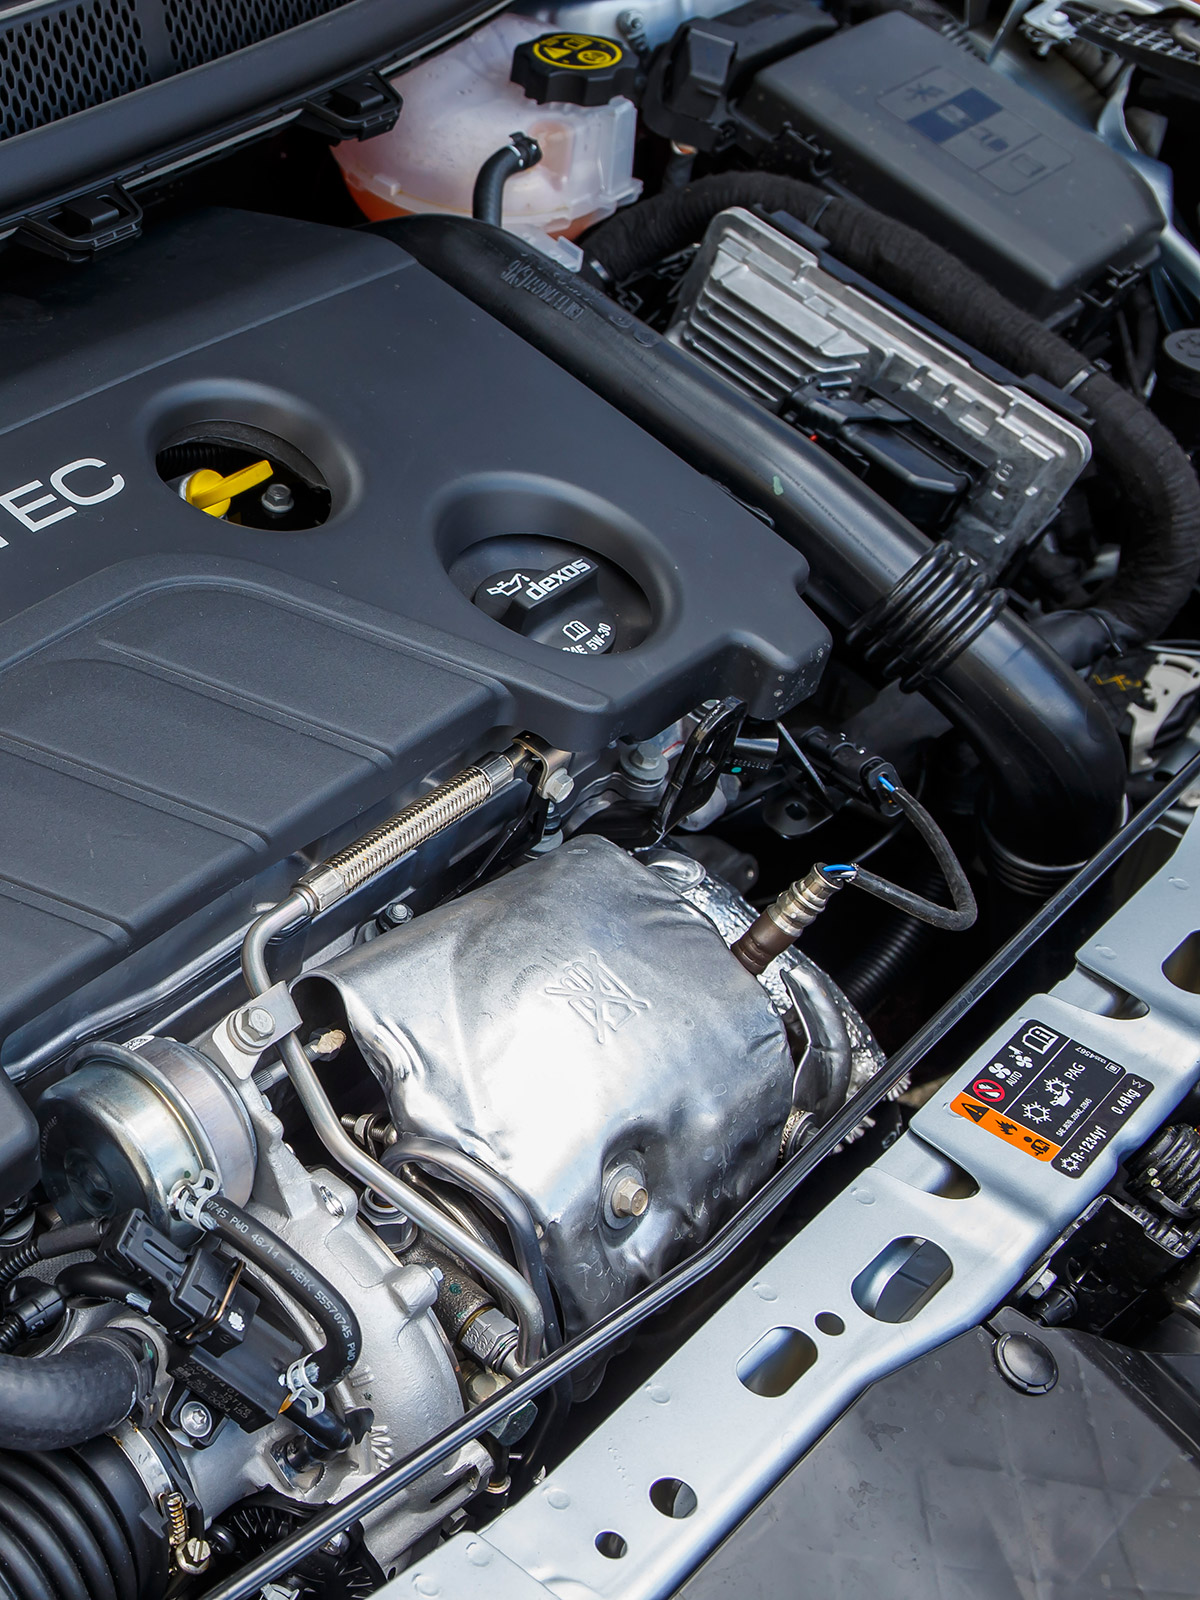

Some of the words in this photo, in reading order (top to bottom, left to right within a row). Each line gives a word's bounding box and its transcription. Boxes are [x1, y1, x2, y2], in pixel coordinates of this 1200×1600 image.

[525, 558, 591, 600] dexos
[585, 622, 612, 651] 5W-30
[1005, 1070, 1023, 1087] AUTO
[1063, 1061, 1086, 1081] PAG
[1070, 1124, 1108, 1163] R-1234yf
[206, 1200, 229, 1219] 0745
[251, 1233, 280, 1259] 48/14
[313, 1290, 353, 1339] 55570745
